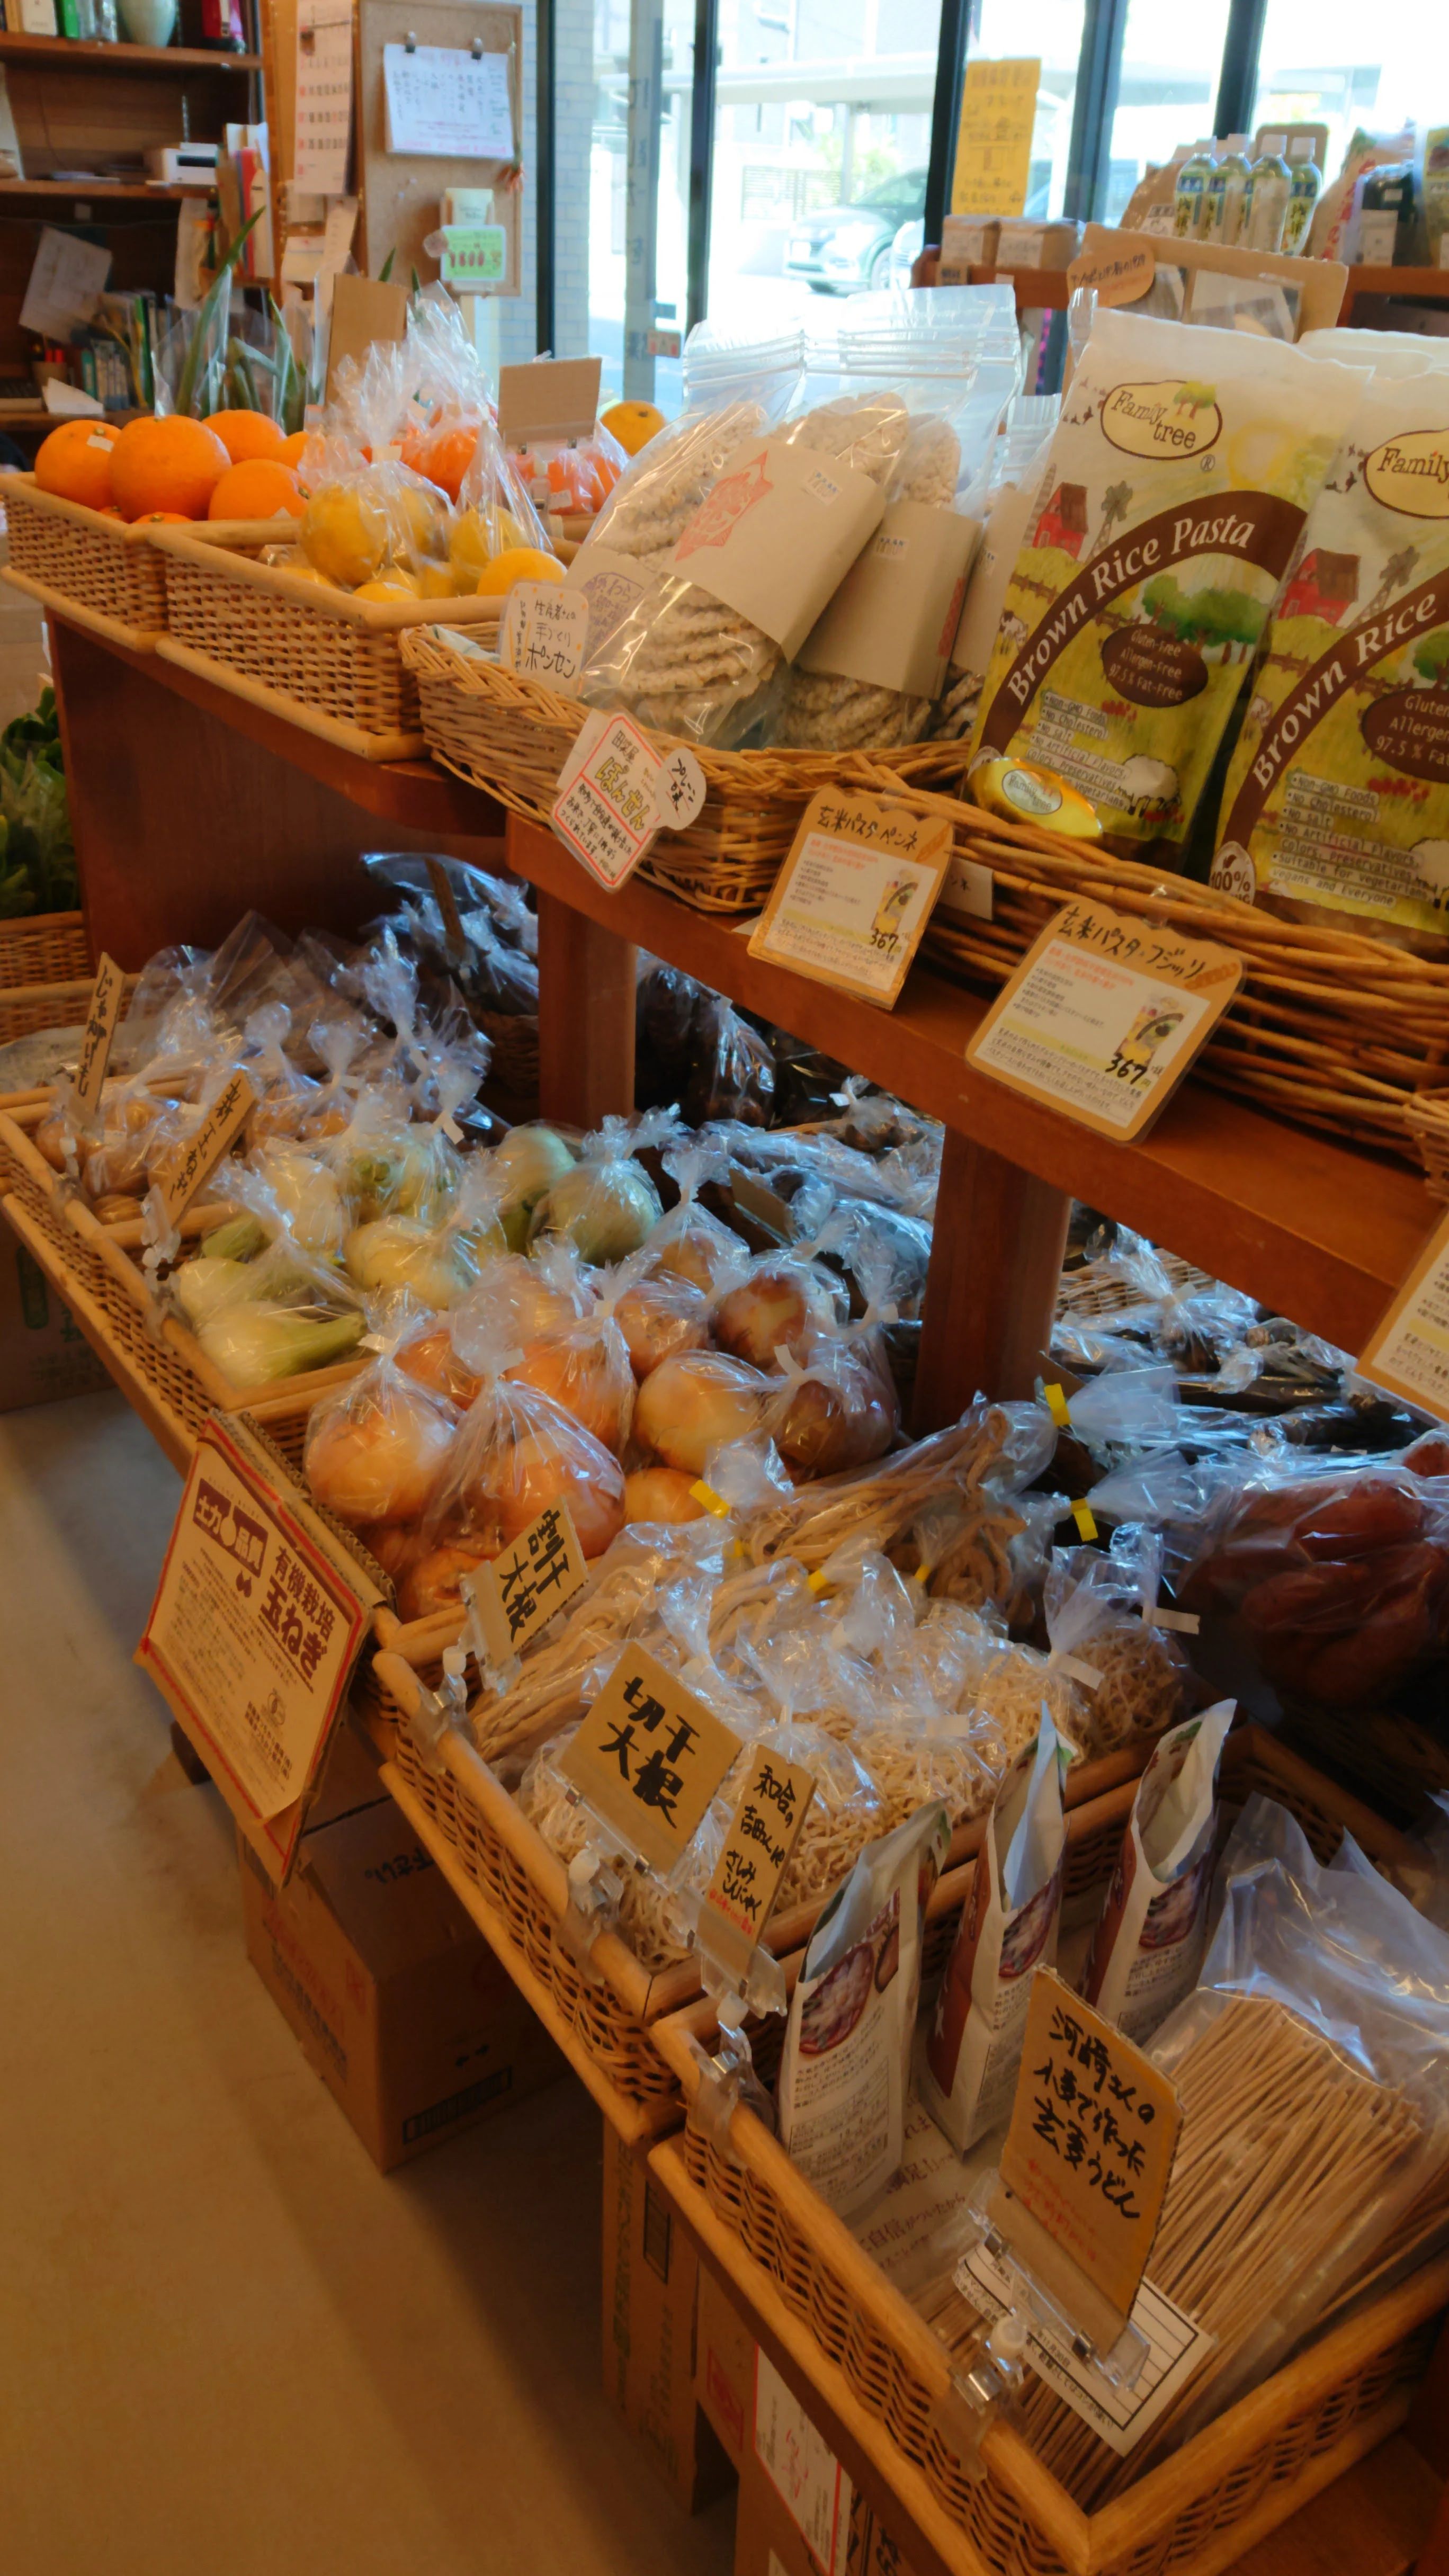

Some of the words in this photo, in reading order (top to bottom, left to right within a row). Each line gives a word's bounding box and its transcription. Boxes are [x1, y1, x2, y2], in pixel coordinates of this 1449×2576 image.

[1111, 390, 1168, 426] Family
[1153, 421, 1196, 450] tree
[1007, 593, 1089, 706] Brown
[1091, 536, 1161, 601] Rice
[1170, 514, 1256, 556] Pasta
[524, 642, 576, 680] ポンセン
[1253, 661, 1347, 791] Brown
[1355, 593, 1436, 666] Rice
[594, 756, 650, 831] ぽんせん
[869, 927, 898, 953] 367
[1105, 1052, 1148, 1085] 367
[259, 1576, 328, 1679] 玉ねぎ
[273, 1544, 336, 1643] 有機栽培
[623, 1676, 701, 1764] 切干
[598, 1721, 684, 1829] 大根
